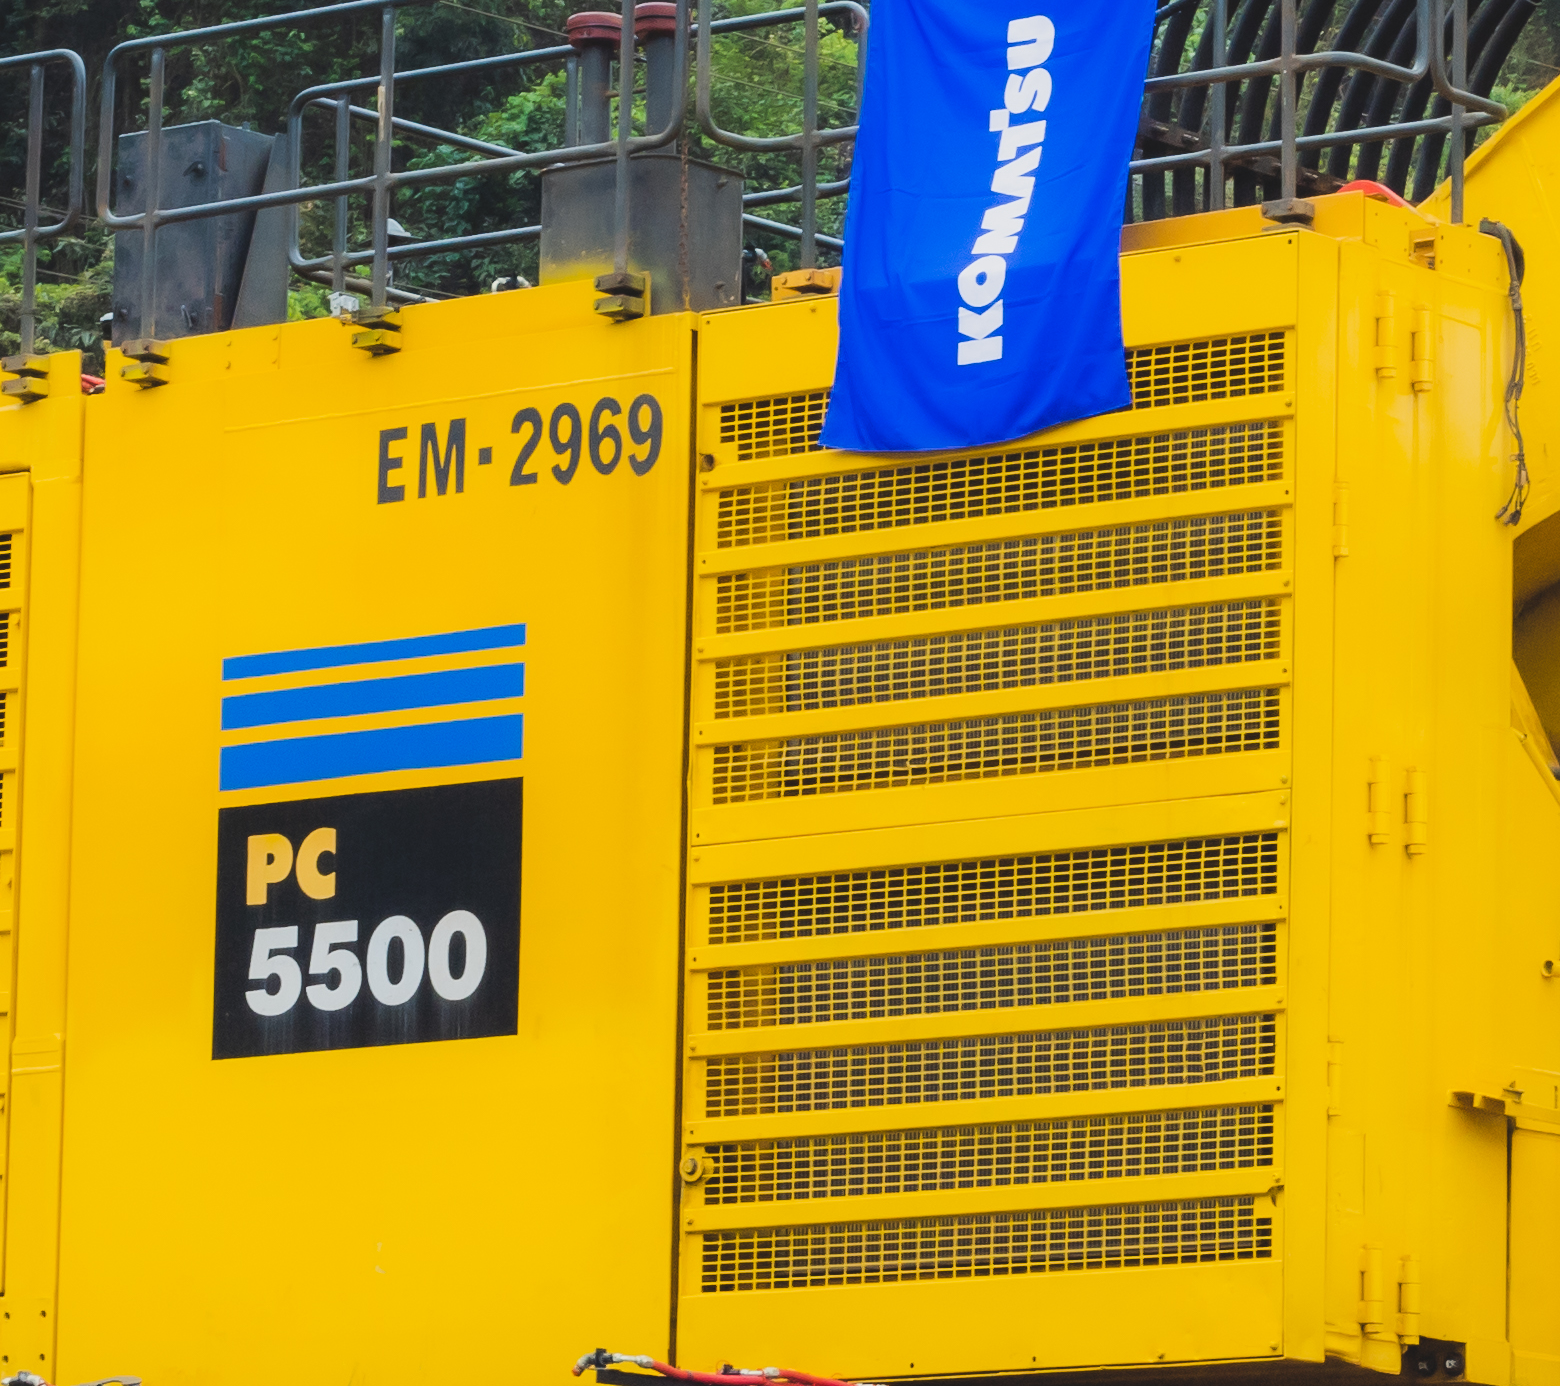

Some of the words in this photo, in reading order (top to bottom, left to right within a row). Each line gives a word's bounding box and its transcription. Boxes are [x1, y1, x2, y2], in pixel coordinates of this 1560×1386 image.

[958, 15, 1055, 365] KOMATSU
[246, 827, 336, 906] PC
[244, 909, 487, 1016] 5500
